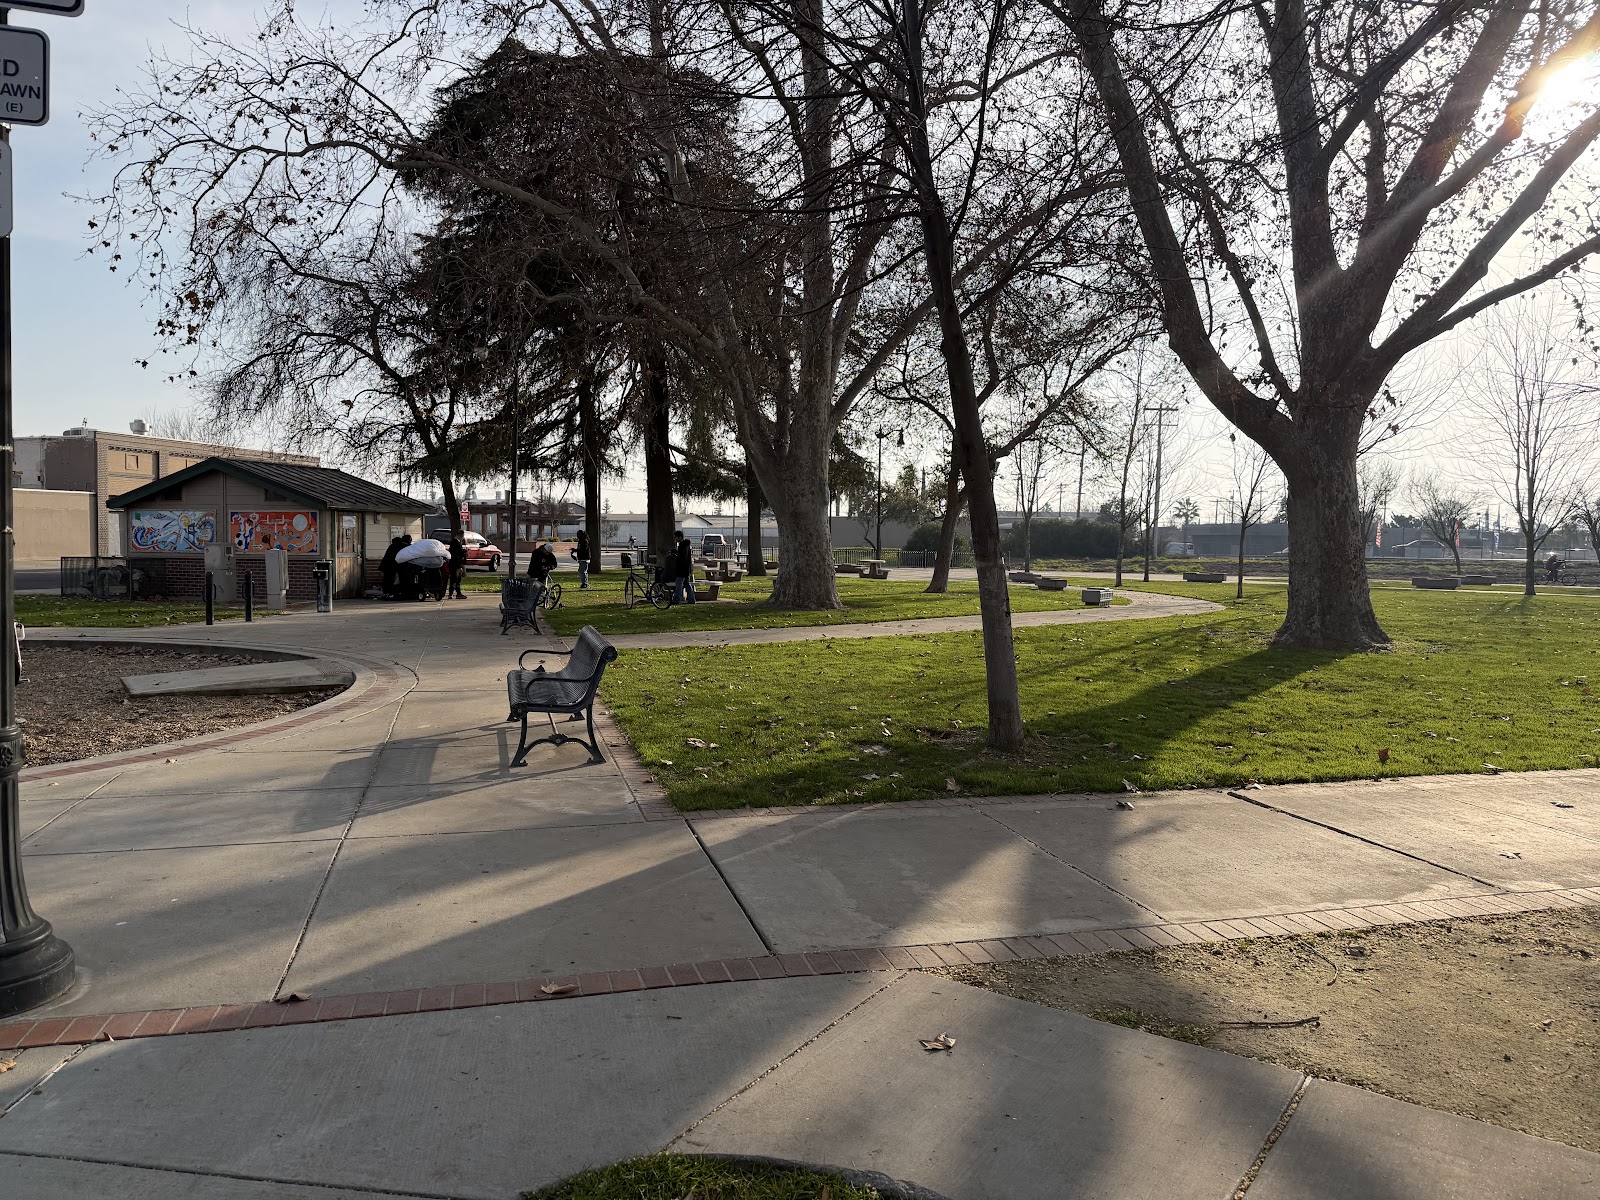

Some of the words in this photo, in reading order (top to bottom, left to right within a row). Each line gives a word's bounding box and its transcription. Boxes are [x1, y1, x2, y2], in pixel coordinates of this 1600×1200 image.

[0, 58, 19, 77] D
[0, 83, 40, 99] AWN
[6, 101, 23, 113] (E)
